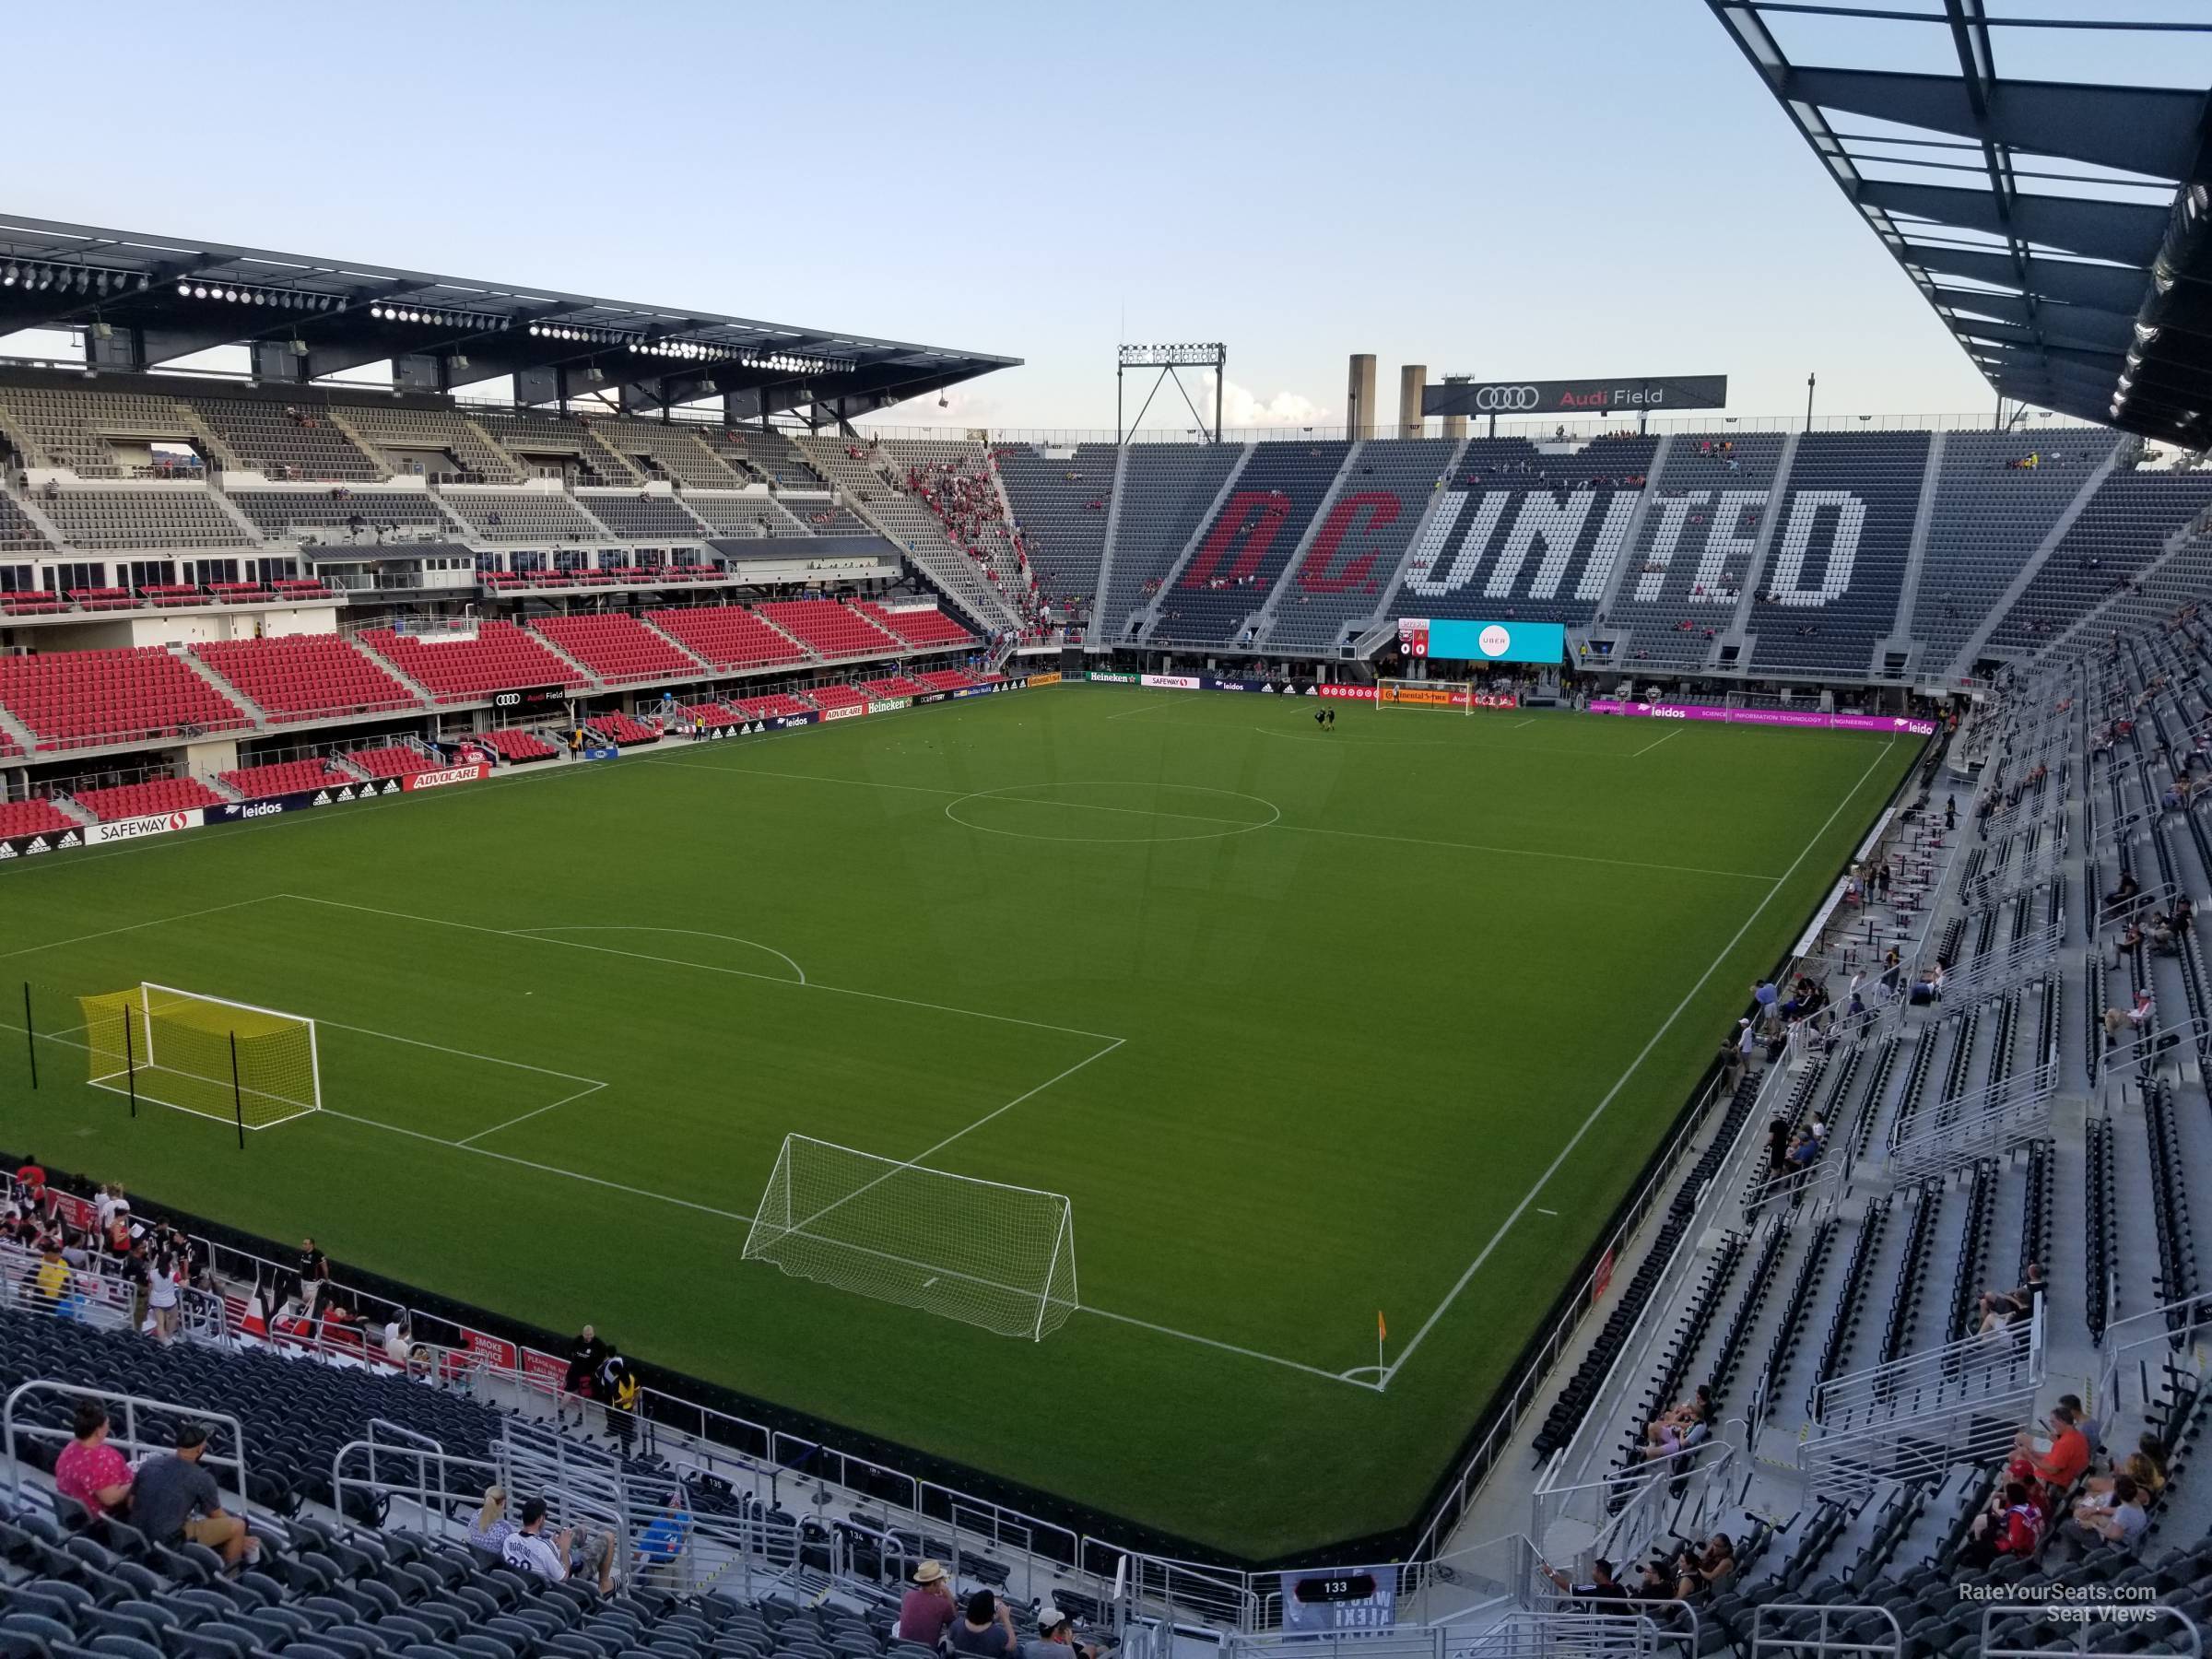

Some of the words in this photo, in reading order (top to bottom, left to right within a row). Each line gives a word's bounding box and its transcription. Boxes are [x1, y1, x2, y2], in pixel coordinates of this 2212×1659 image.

[1560, 390, 1607, 406] Audi
[1614, 388, 1664, 405] Field
[1405, 490, 1867, 606] UNITED
[1090, 672, 1128, 683] Heineken
[1152, 677, 1180, 686] SAFEWAY
[546, 690, 563, 700] Field
[826, 706, 863, 720] ADVOCARE
[868, 700, 905, 714] Heineken
[1652, 707, 1686, 718] leidos
[786, 717, 808, 728] leidos
[1735, 712, 1778, 721] INFORMATION
[1779, 715, 1822, 724] TECHNOLOGY
[414, 766, 479, 788] ADVOCARE
[242, 802, 282, 818] leidos
[100, 817, 169, 841] SAFEWAY
[26, 845, 52, 855] adidas
[57, 840, 82, 850] adidas
[475, 1336, 502, 1353] SMOKE
[1324, 1582, 1347, 1594] 133
